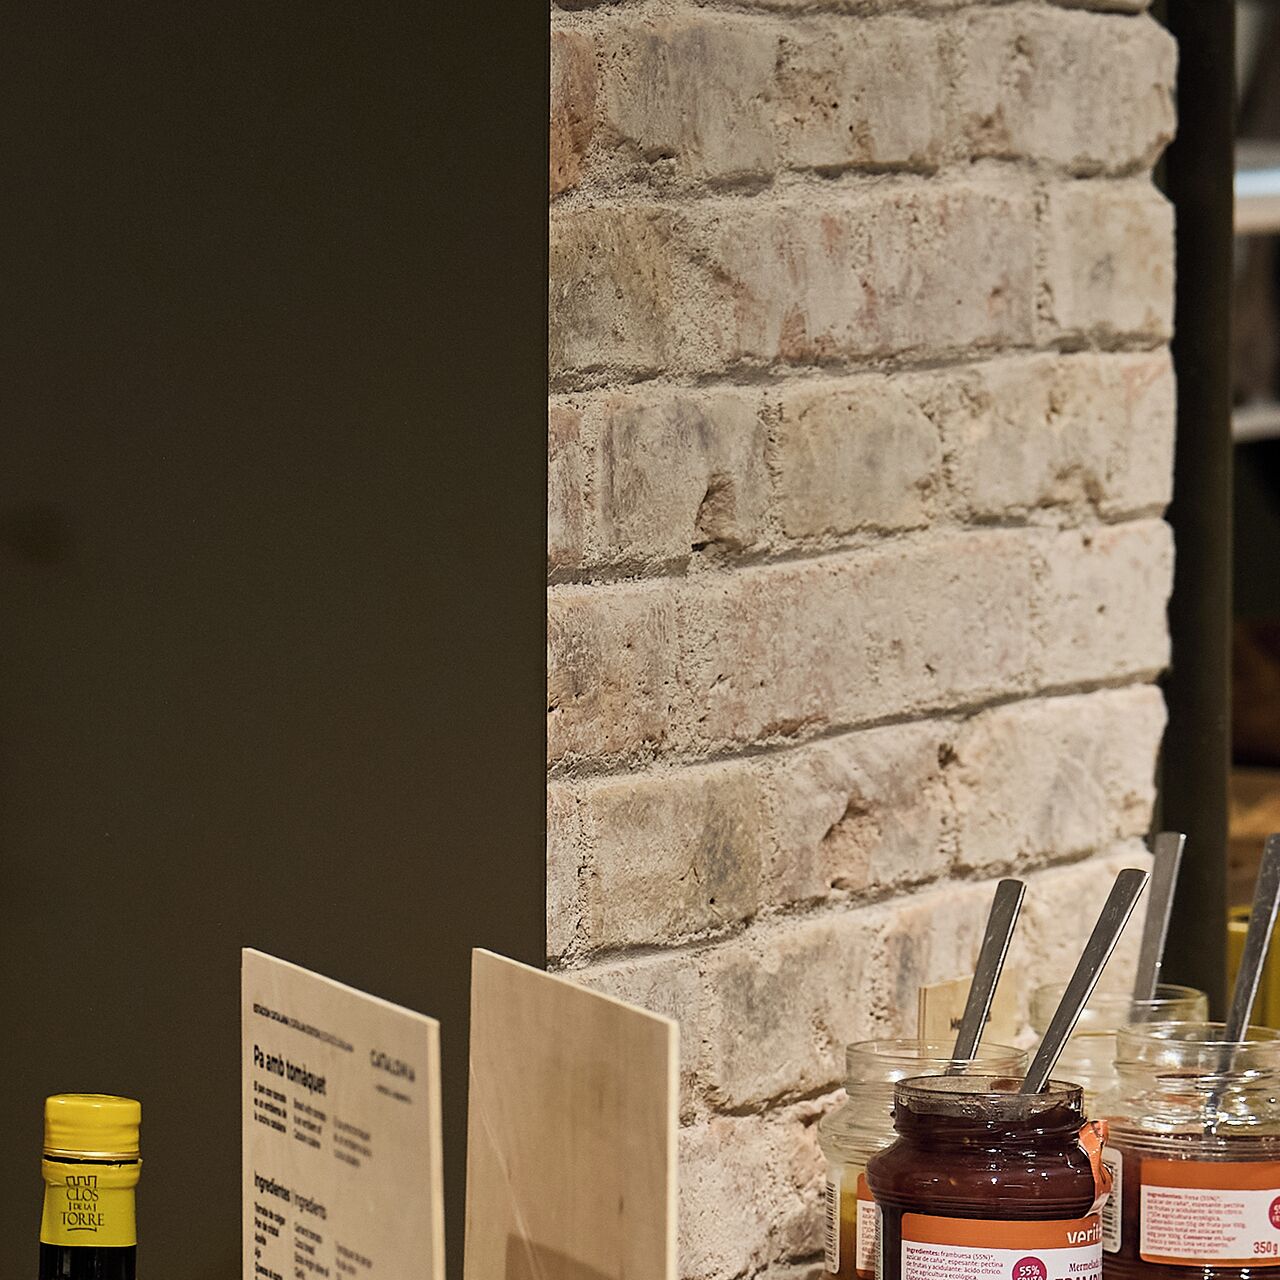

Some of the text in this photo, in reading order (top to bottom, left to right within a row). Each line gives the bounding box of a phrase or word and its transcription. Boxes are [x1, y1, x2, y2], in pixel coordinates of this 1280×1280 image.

[254, 1044, 264, 1068] Pa
[266, 1052, 284, 1077] amb
[67, 1188, 98, 1201] CLOS
[61, 1212, 104, 1226] TORRE
[906, 1246, 939, 1257] Ingredientes:
[1020, 1265, 1040, 1276] 55%
